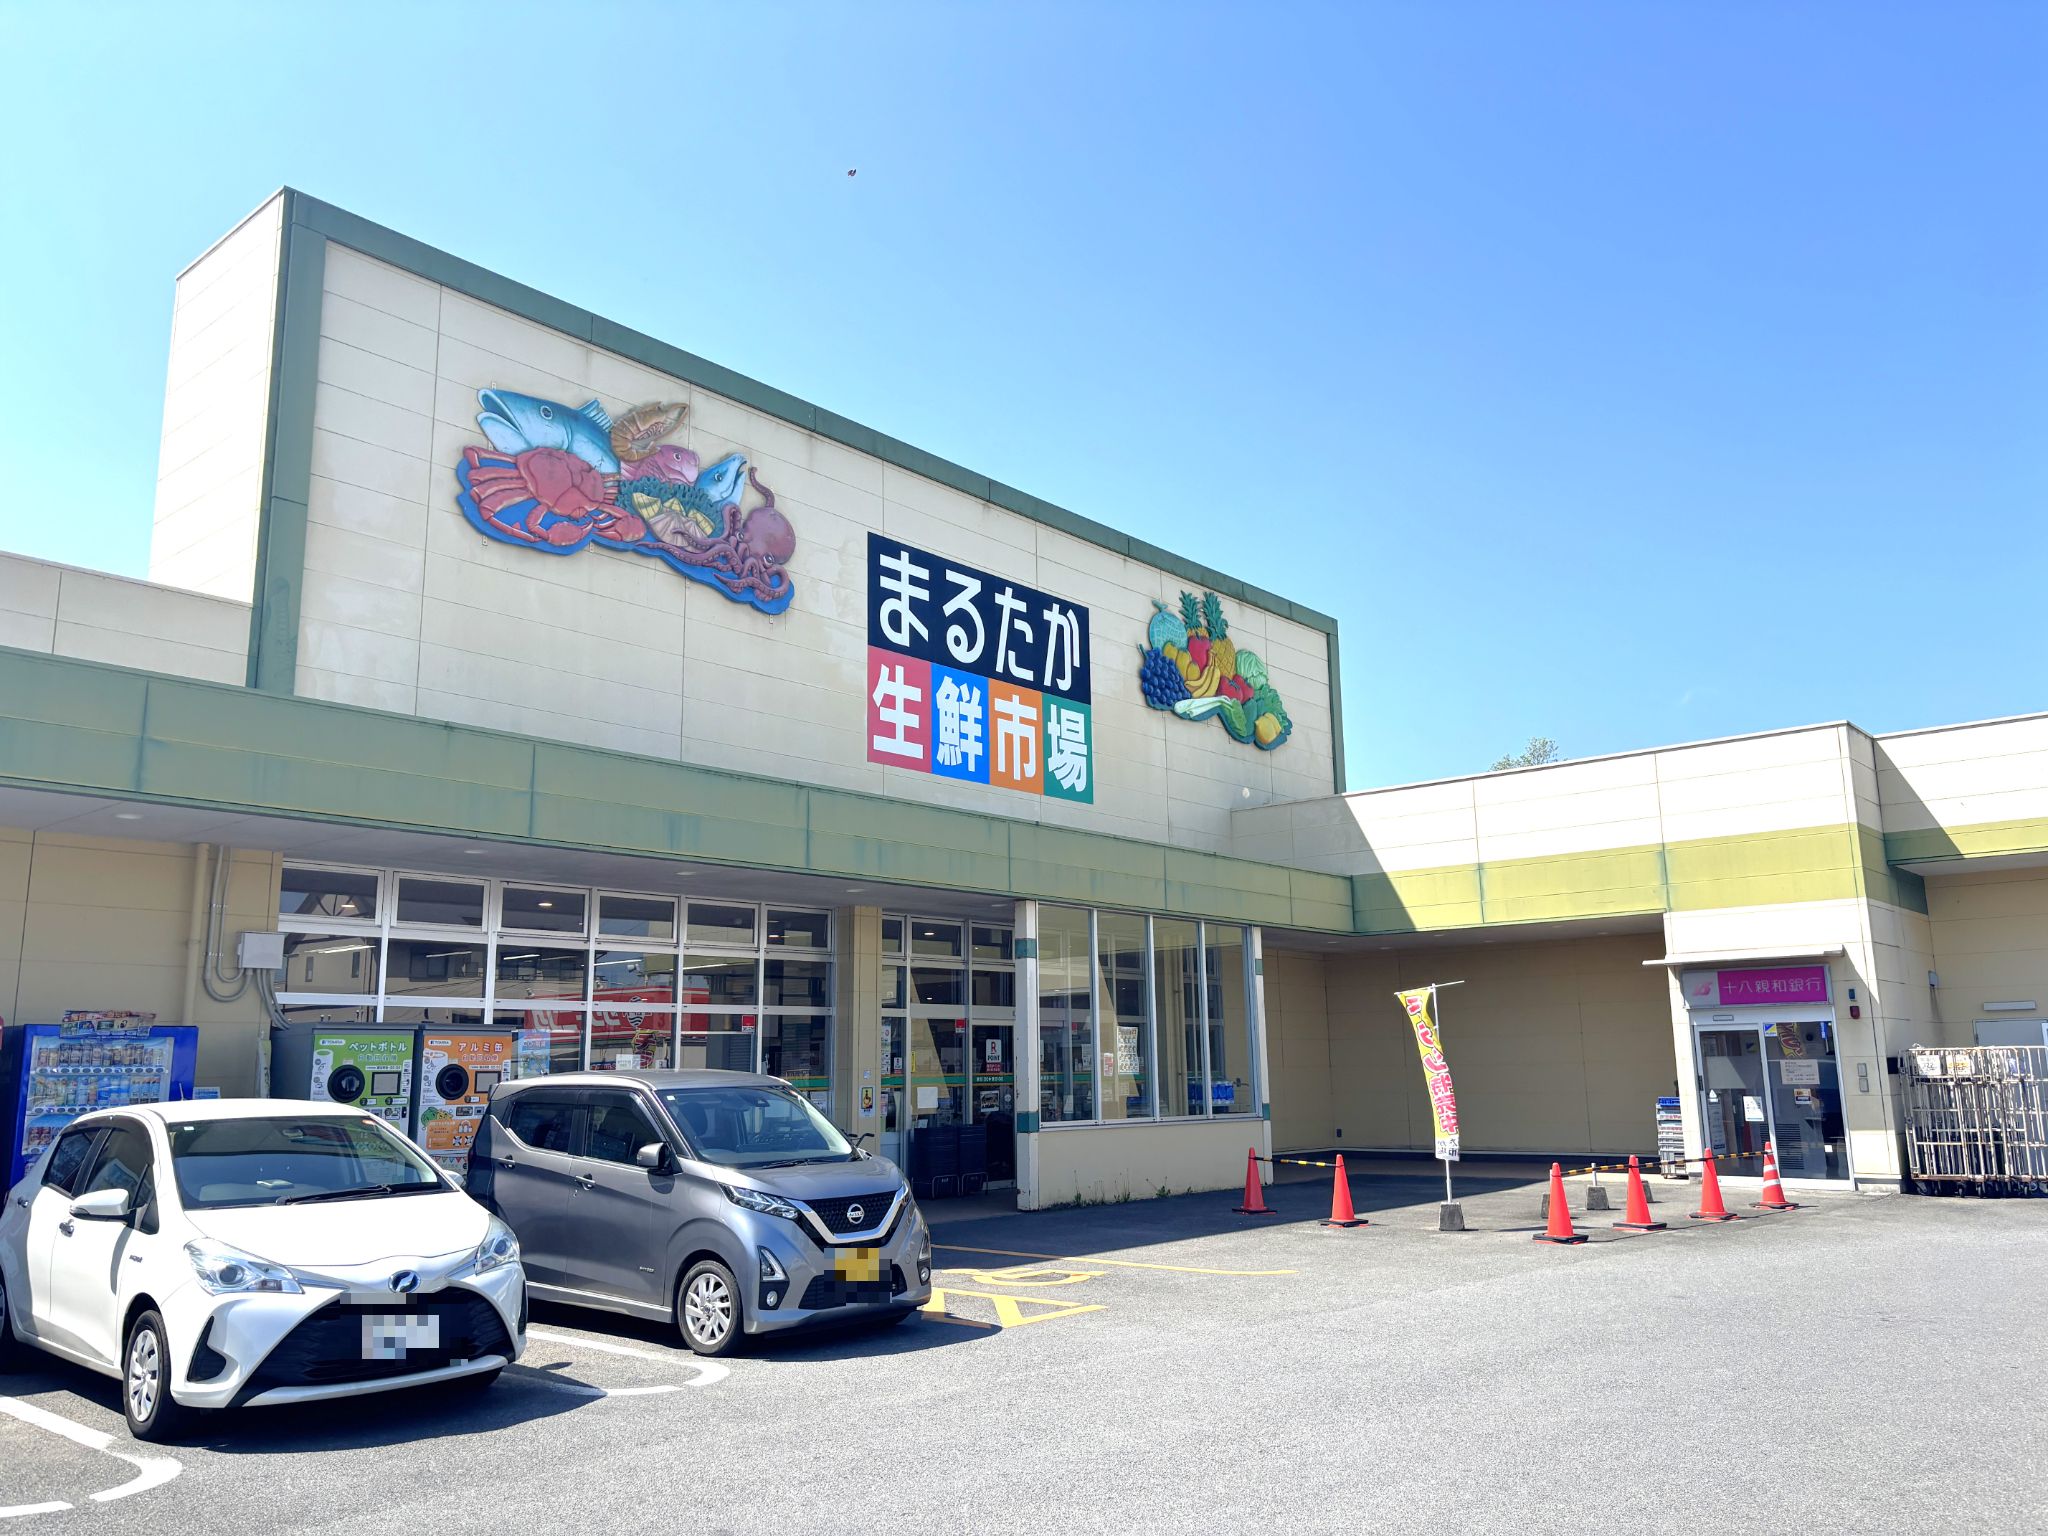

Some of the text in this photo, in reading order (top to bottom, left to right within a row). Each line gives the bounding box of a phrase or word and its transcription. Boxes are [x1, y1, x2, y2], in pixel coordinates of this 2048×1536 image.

[879, 550, 1081, 691] まるたか
[872, 664, 1088, 793] 生鮮市場
[1722, 977, 1821, 994] 十八親和銀行
[349, 1042, 407, 1052] ペットボトル
[458, 1042, 503, 1052] アルミ缶
